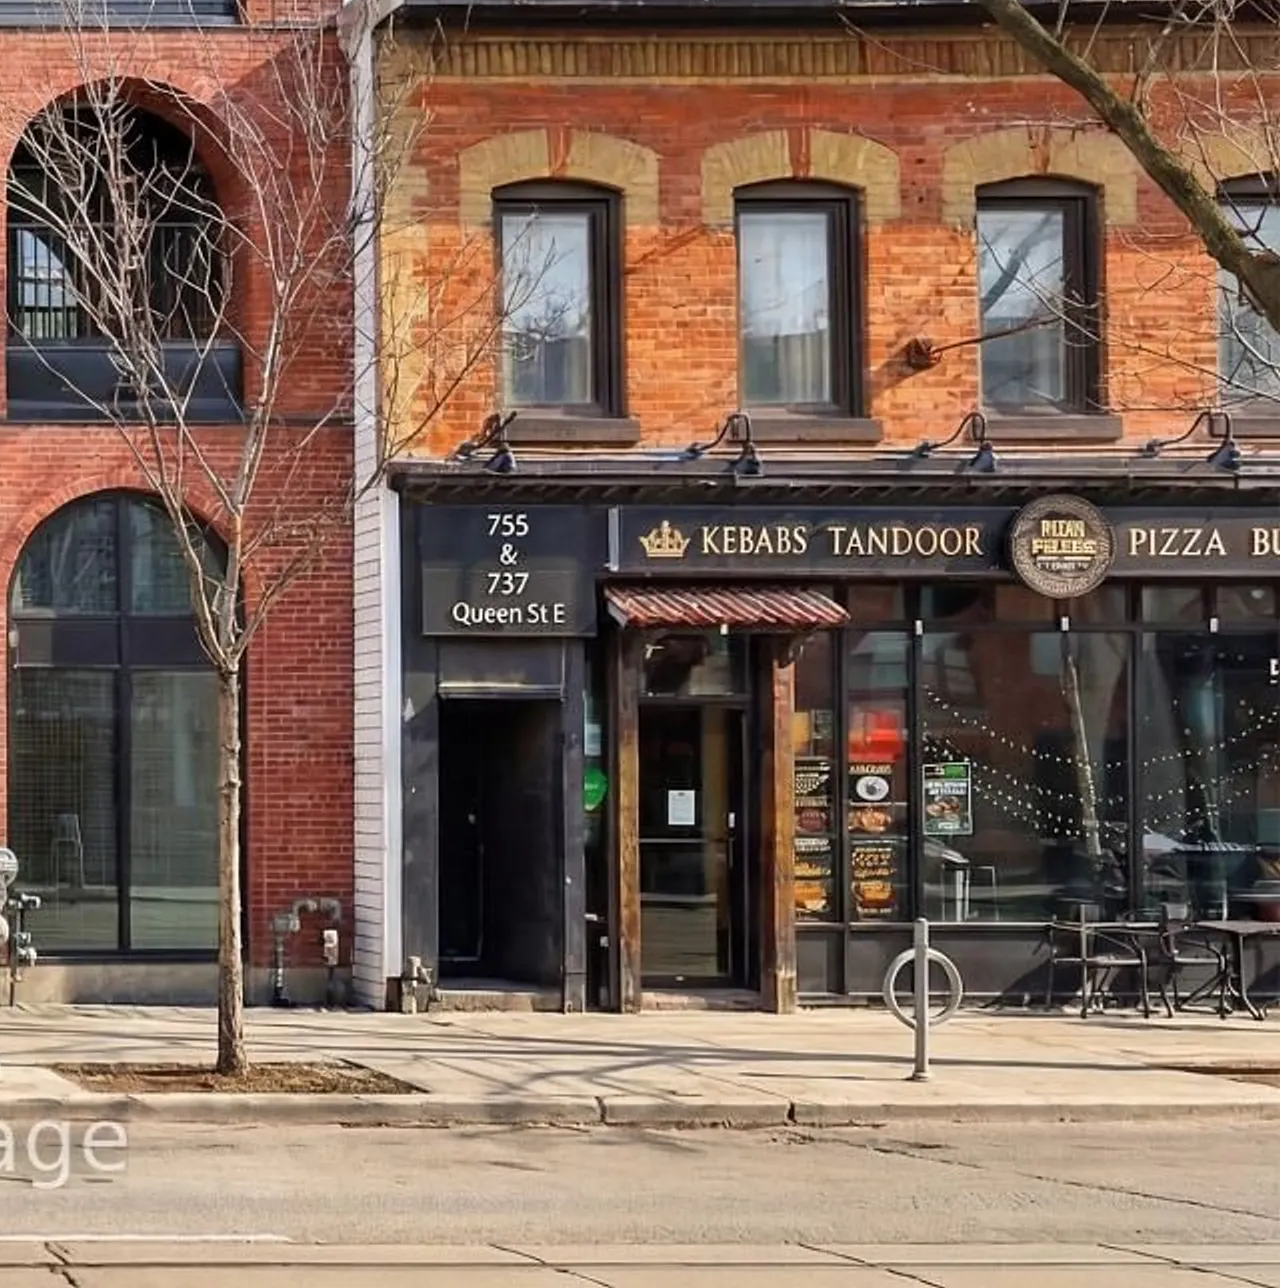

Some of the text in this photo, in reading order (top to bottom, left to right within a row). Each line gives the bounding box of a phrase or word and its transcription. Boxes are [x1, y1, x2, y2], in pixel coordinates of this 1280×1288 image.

[487, 514, 529, 537] 755
[701, 526, 984, 557] KEBABS TANDOOR
[1129, 527, 1227, 556] PIZZA
[500, 543, 519, 565] &
[487, 572, 529, 596] 737
[452, 602, 566, 625] Queen St E
